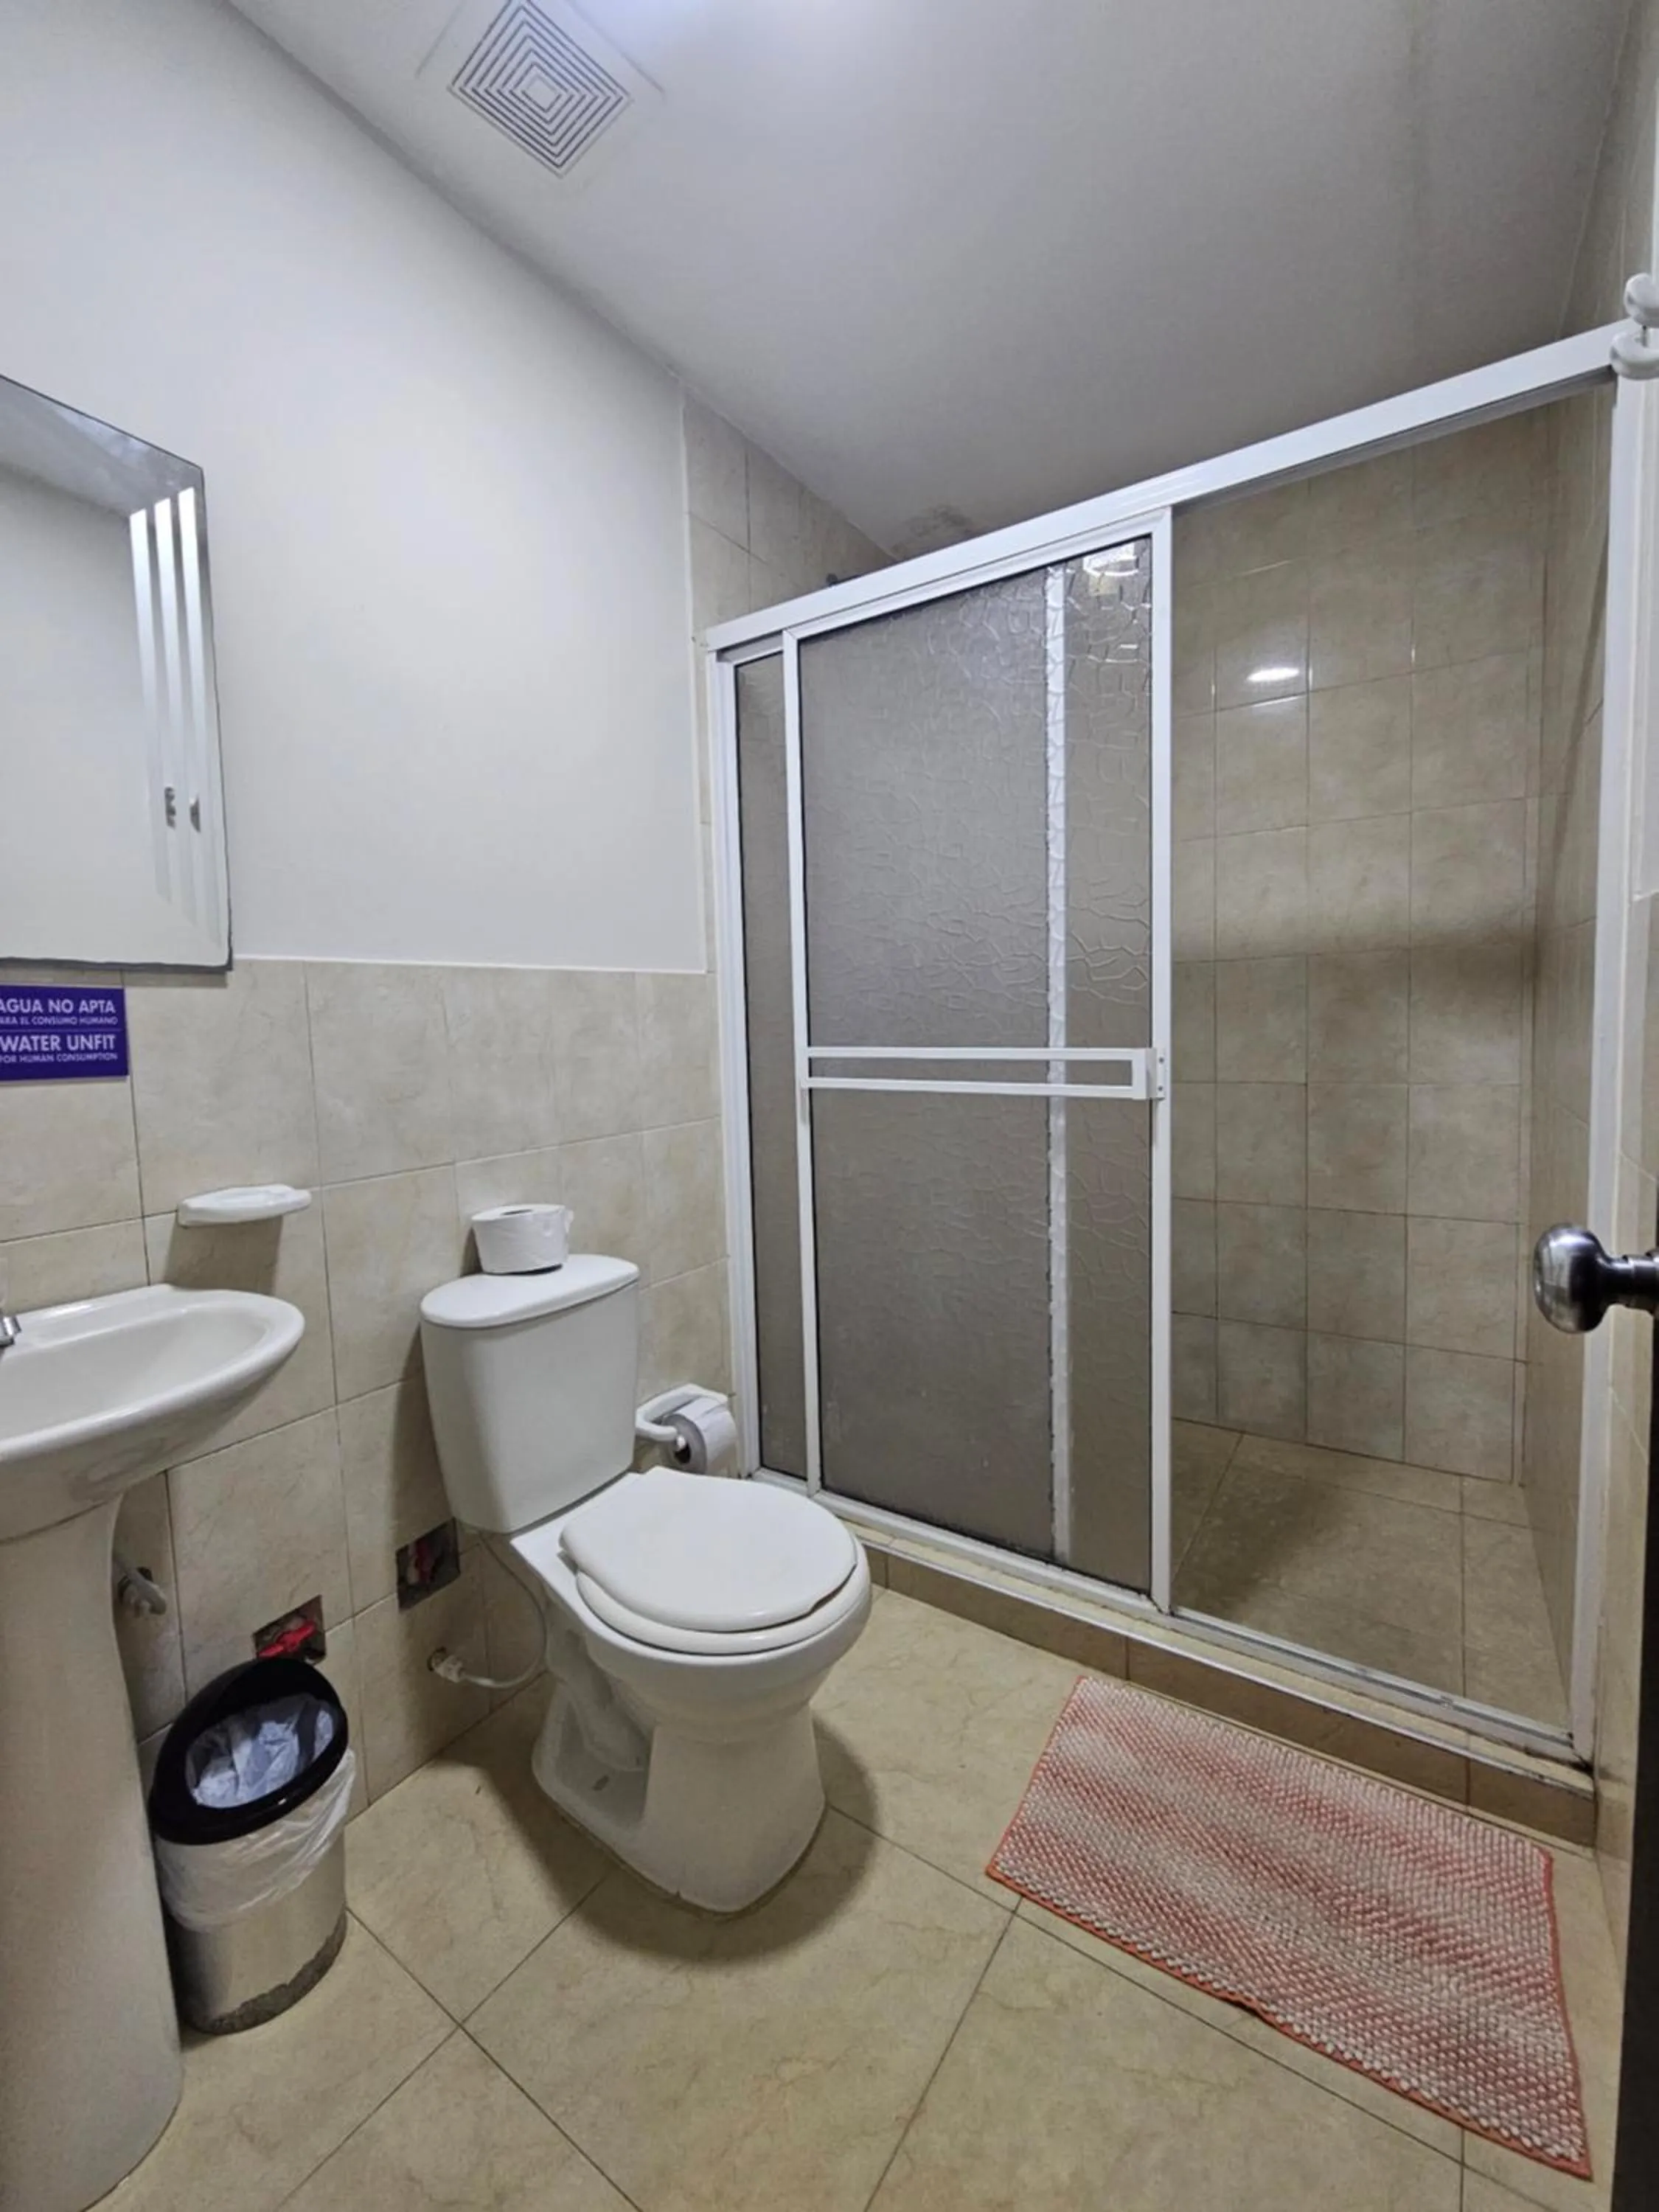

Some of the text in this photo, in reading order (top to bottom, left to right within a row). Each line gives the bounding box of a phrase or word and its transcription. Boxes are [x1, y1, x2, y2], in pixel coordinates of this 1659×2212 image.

[0, 998, 116, 1013] AGUA NO APTA
[32, 1017, 77, 1025] CONSUMO
[80, 1017, 118, 1025] HUMANO
[0, 1034, 116, 1052] WATER UNFIT
[19, 1054, 55, 1062] HUMAN
[57, 1052, 118, 1062] CONSUMPTION
